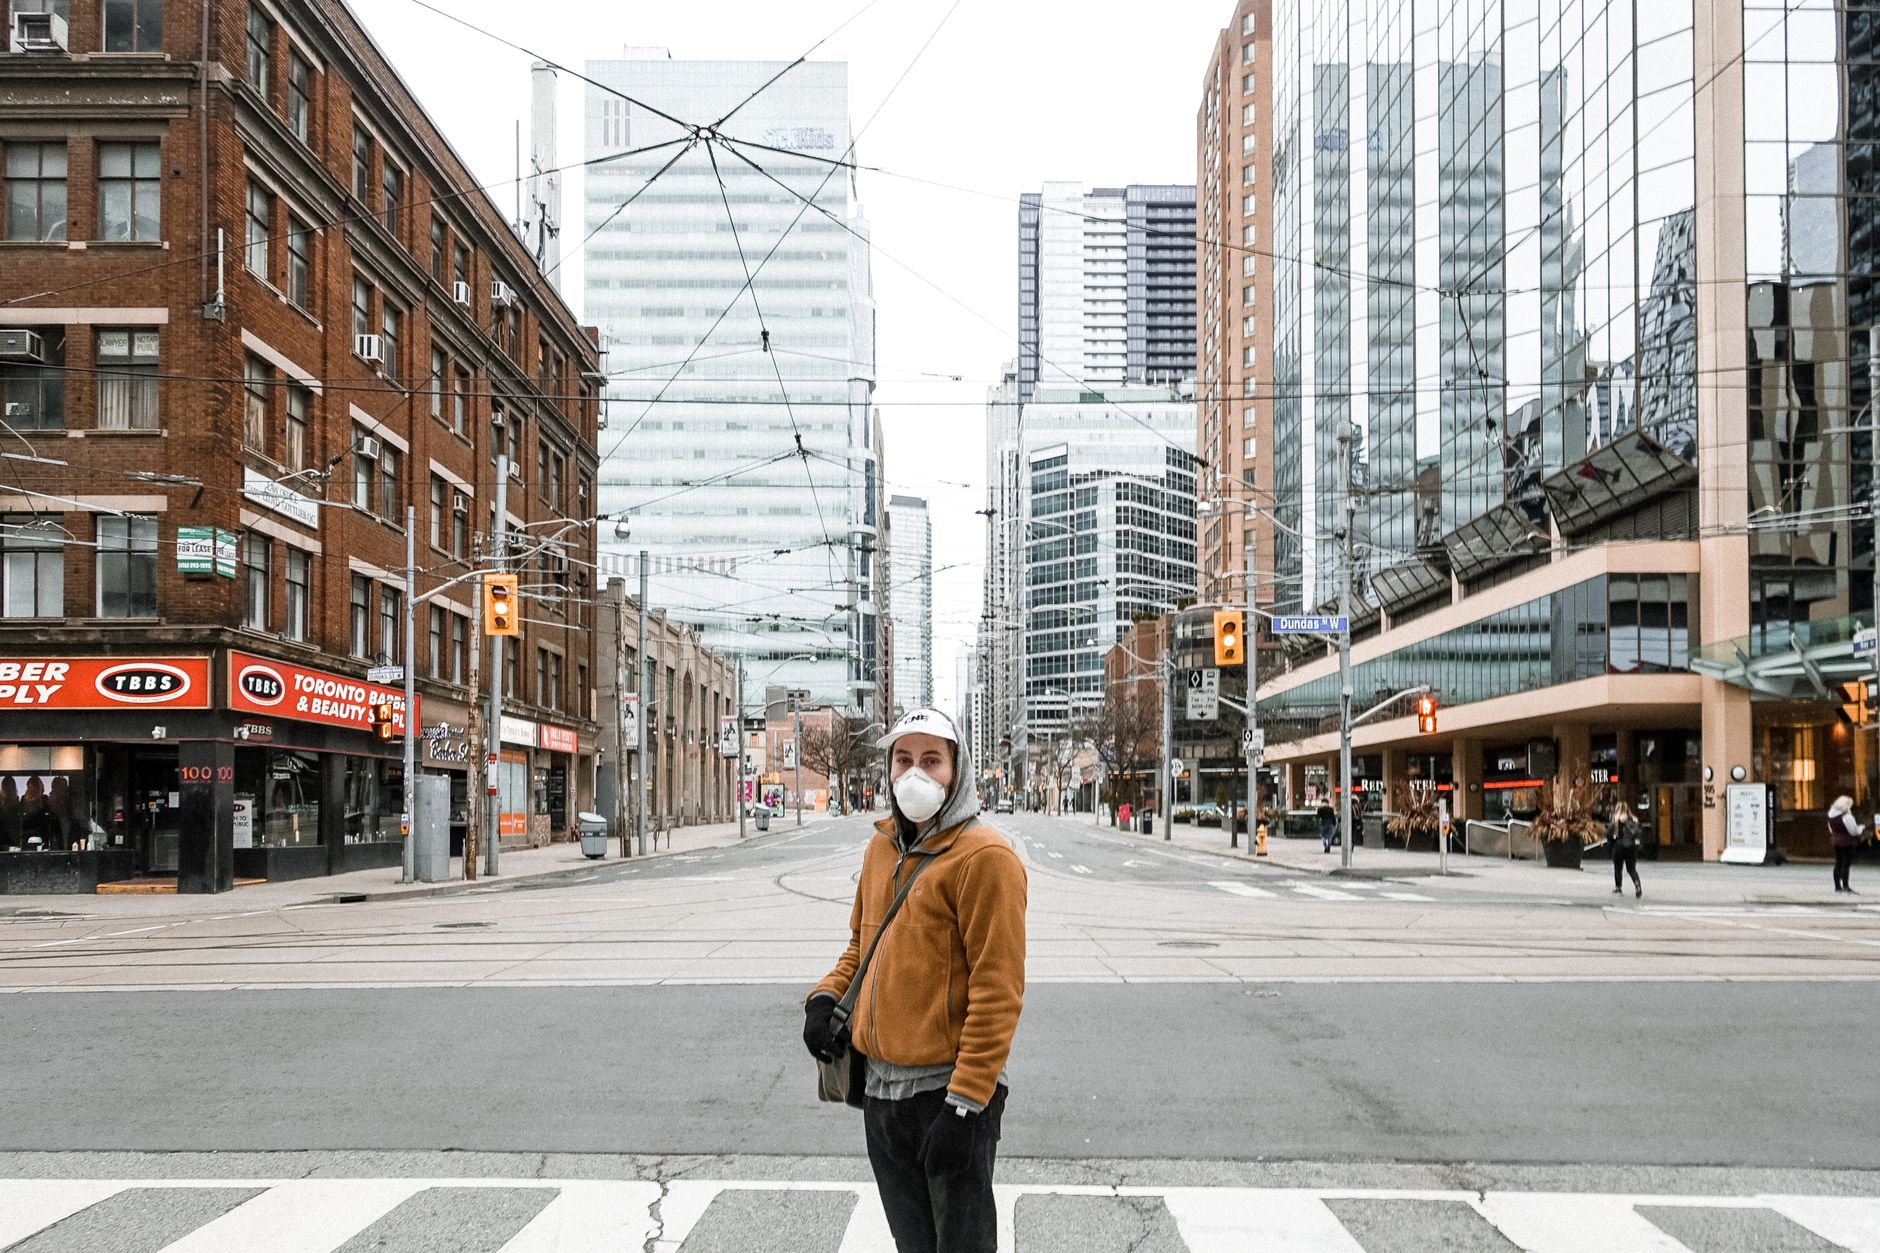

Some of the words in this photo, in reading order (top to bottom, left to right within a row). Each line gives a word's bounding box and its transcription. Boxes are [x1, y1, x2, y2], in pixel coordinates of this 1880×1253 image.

[100, 339, 128, 347] LAWYER
[192, 544, 211, 553] LEASE
[1280, 617, 1320, 630] Dundas
[1329, 617, 1340, 630] W
[0, 663, 70, 682] BER
[115, 675, 172, 691] TBBS
[247, 676, 278, 696] TBBS
[294, 673, 366, 704] TORONTO
[369, 691, 413, 711] BARBE
[296, 696, 309, 713] &
[311, 697, 366, 723] BEAUTY
[244, 723, 272, 736] TBBS
[182, 767, 212, 780] 100
[217, 767, 233, 780] 100
